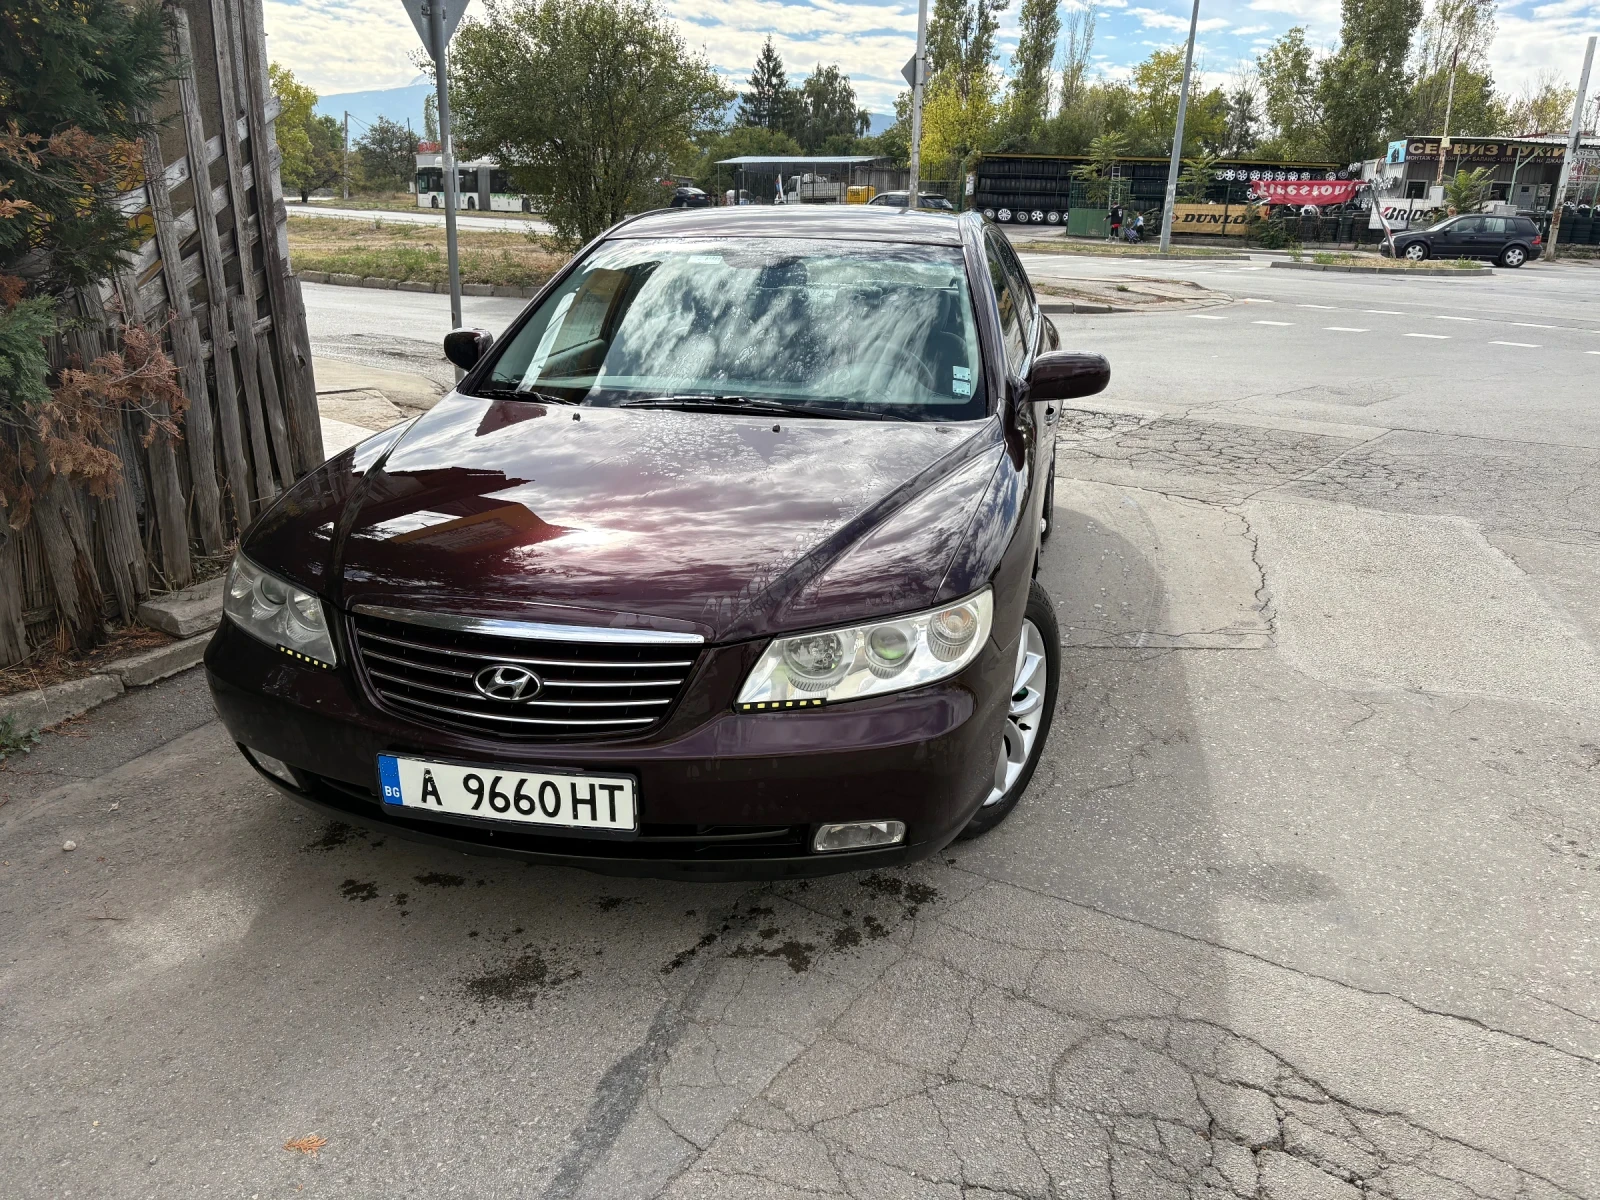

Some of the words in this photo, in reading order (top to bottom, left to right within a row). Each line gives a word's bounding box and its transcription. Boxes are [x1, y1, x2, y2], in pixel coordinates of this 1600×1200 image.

[1408, 142, 1499, 155] СЕРВИЗ
[1380, 207, 1435, 221] BRIDG
[384, 785, 400, 798] BG
